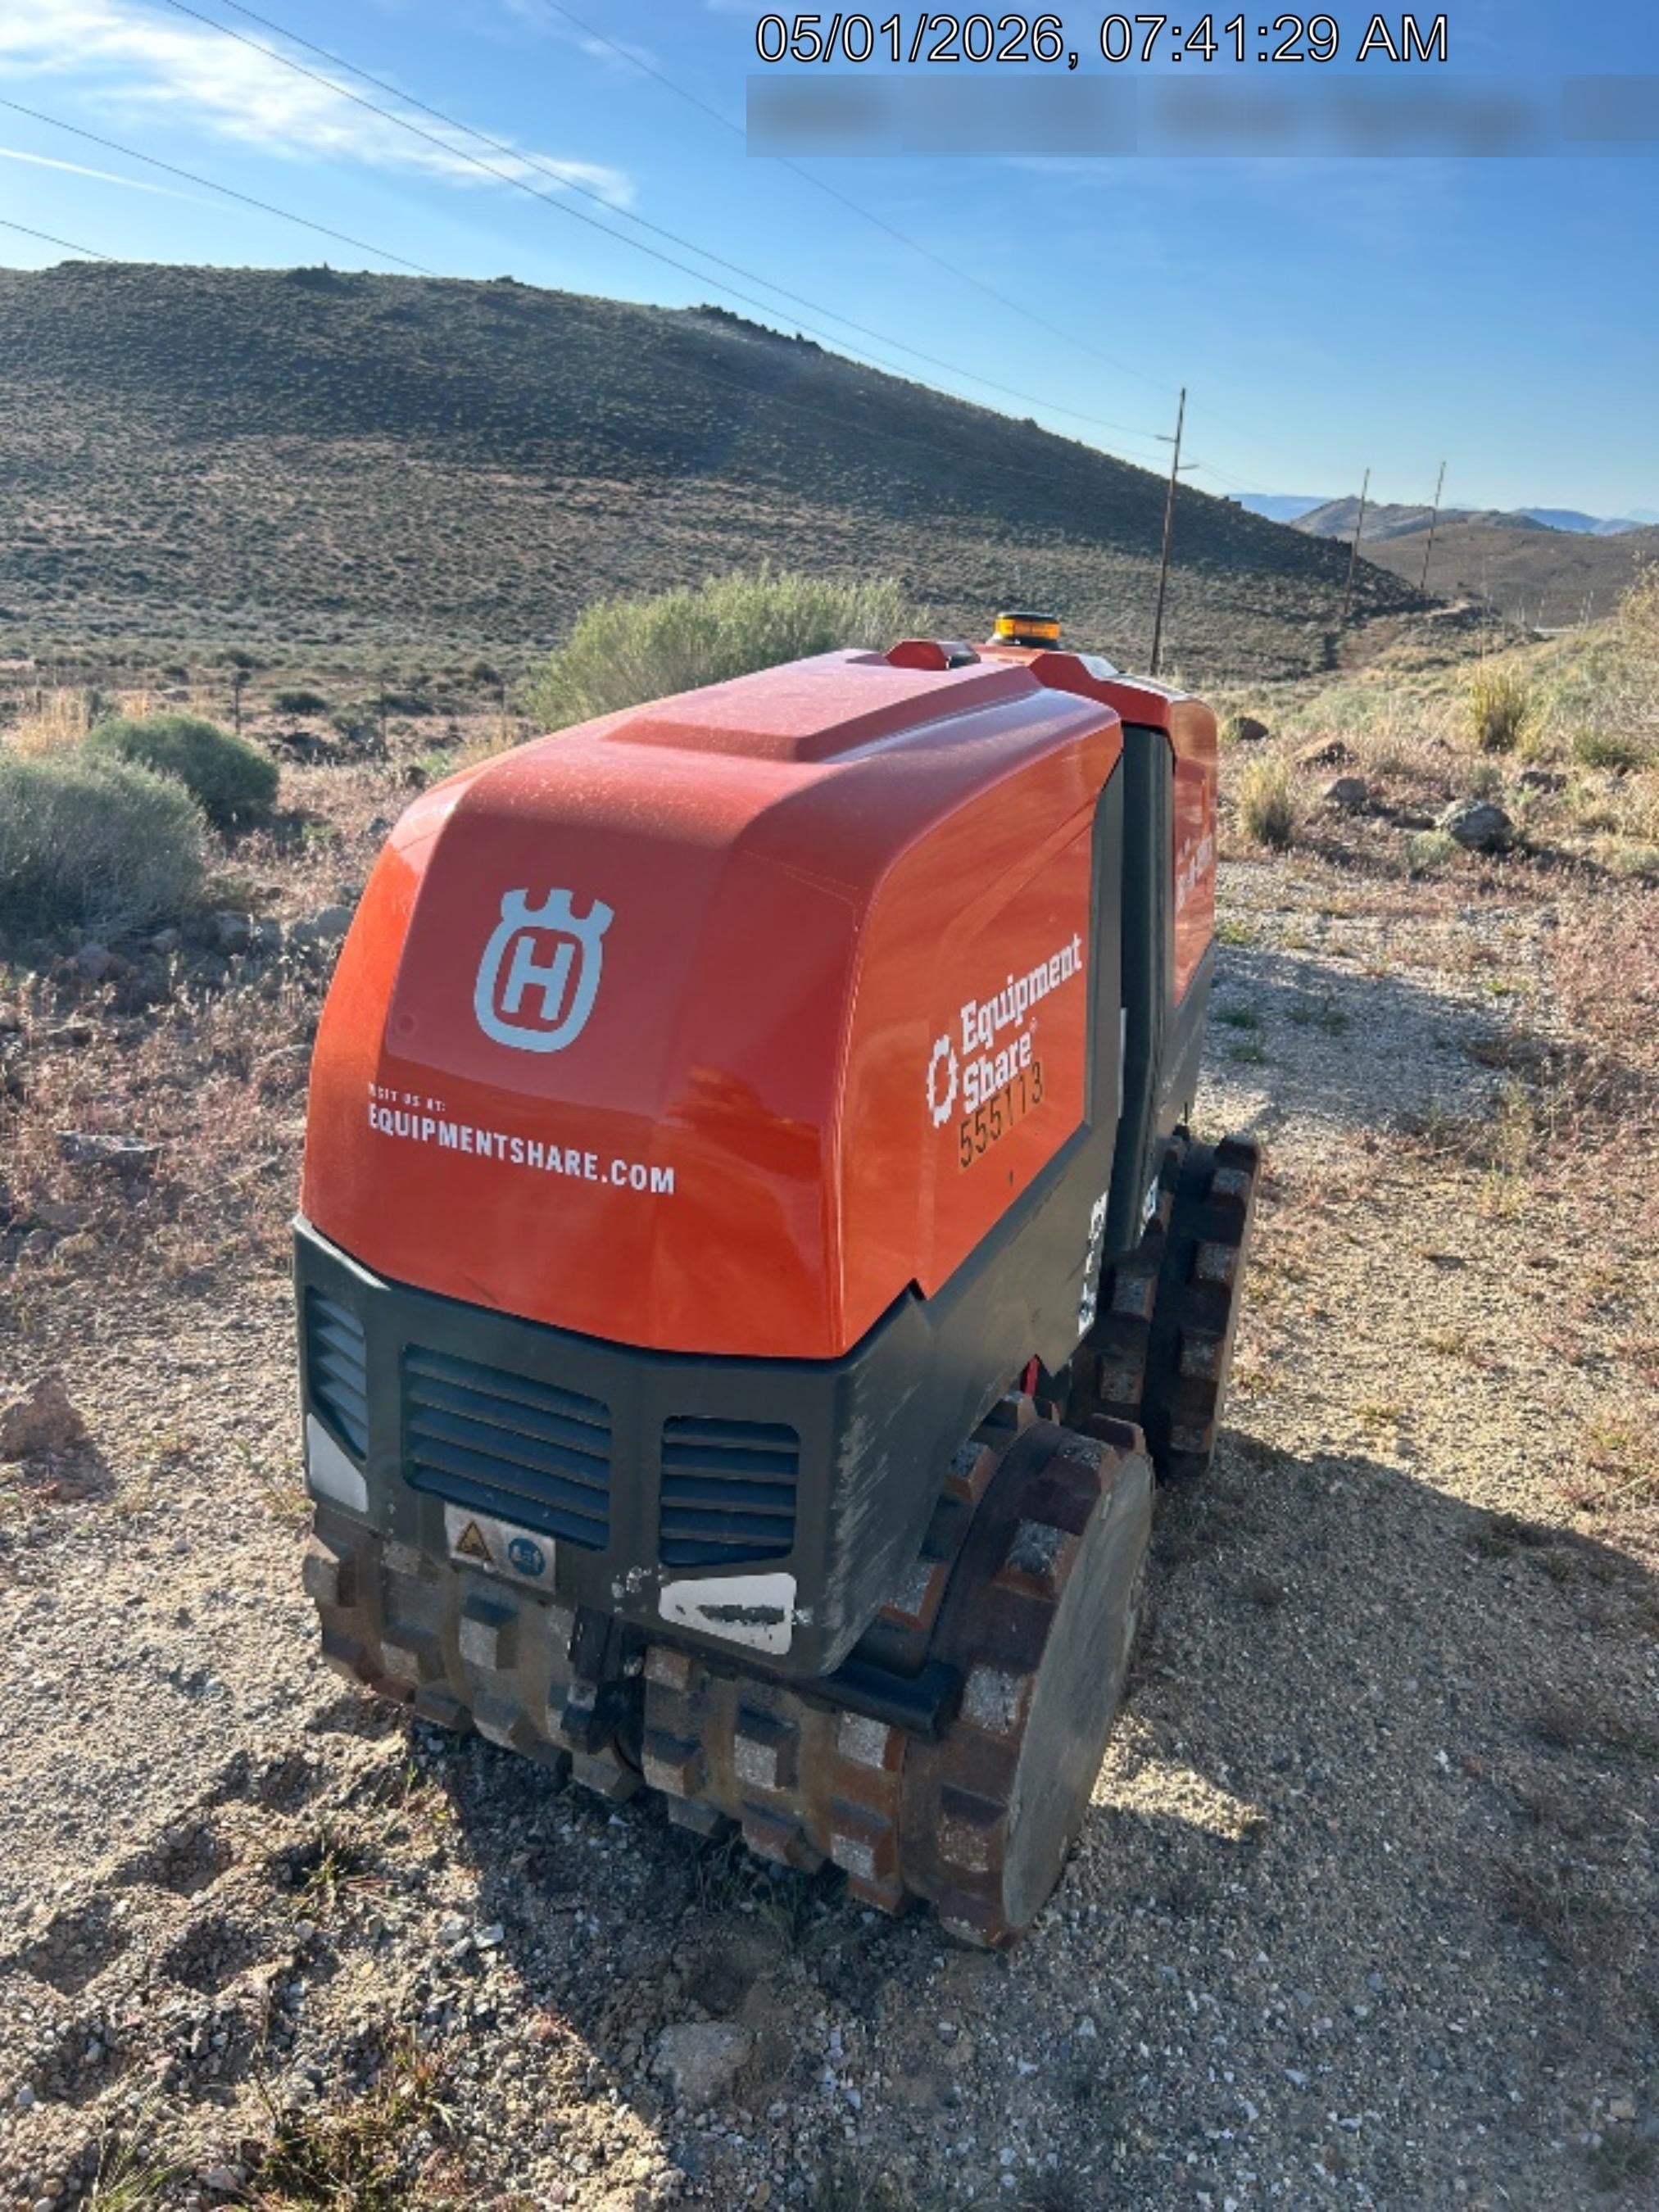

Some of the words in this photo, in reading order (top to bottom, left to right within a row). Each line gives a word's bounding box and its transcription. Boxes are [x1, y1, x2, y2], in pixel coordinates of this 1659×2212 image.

[960, 932, 1082, 1056] Equipment
[368, 1101, 676, 1195] EQUIPMENTSHARE.COM
[958, 1061, 1044, 1168] 555113
